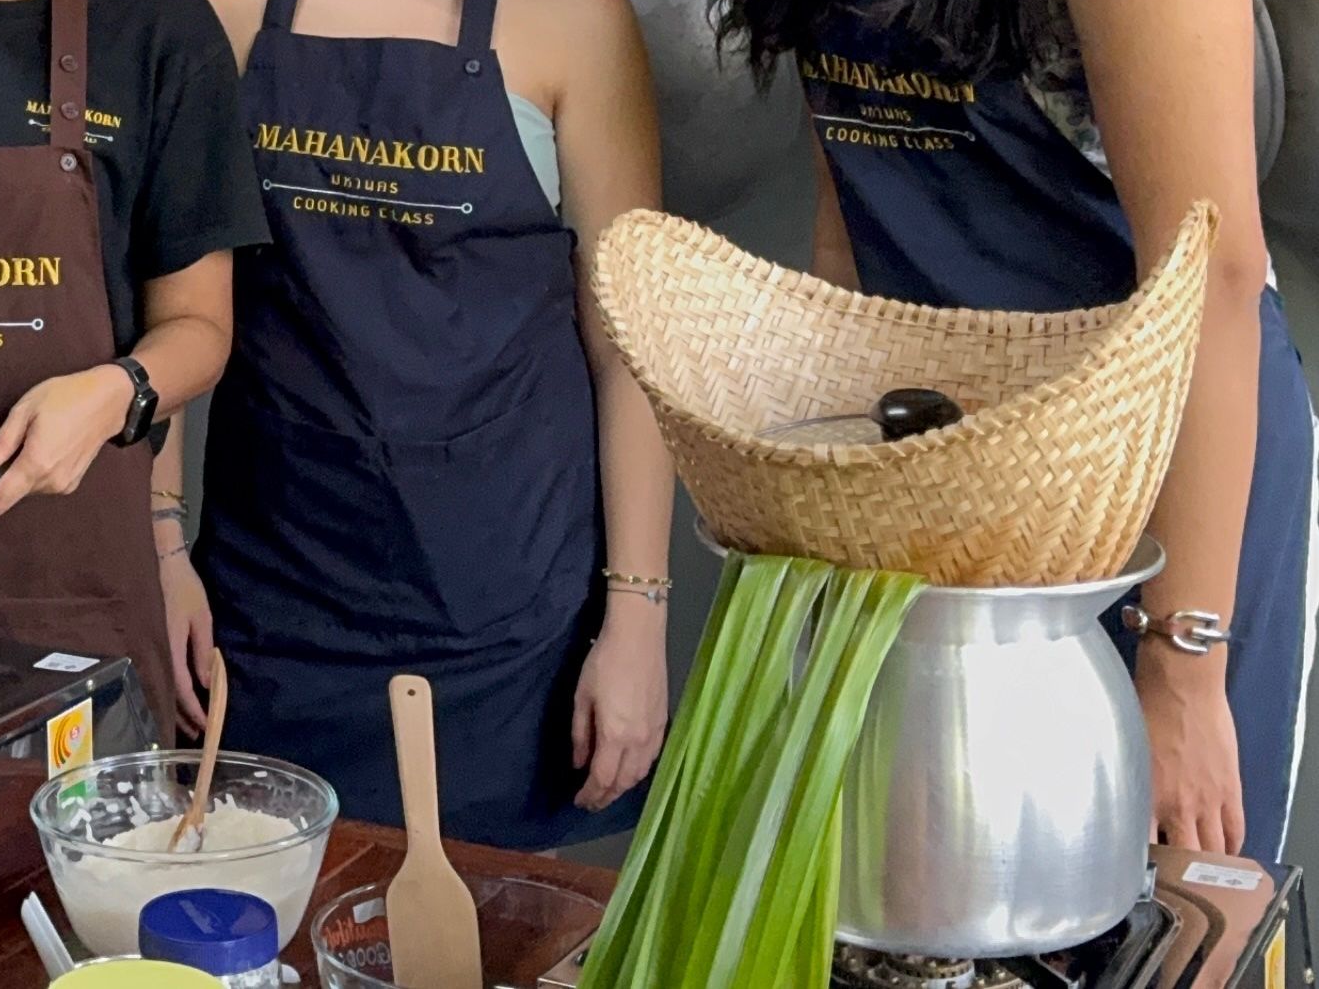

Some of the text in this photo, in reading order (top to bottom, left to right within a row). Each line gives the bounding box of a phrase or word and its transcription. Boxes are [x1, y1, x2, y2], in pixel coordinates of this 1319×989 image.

[253, 123, 485, 173] MAHANAKORN
[825, 126, 955, 151] COOKING CLASS
[293, 196, 435, 225] COOKING CLASS
